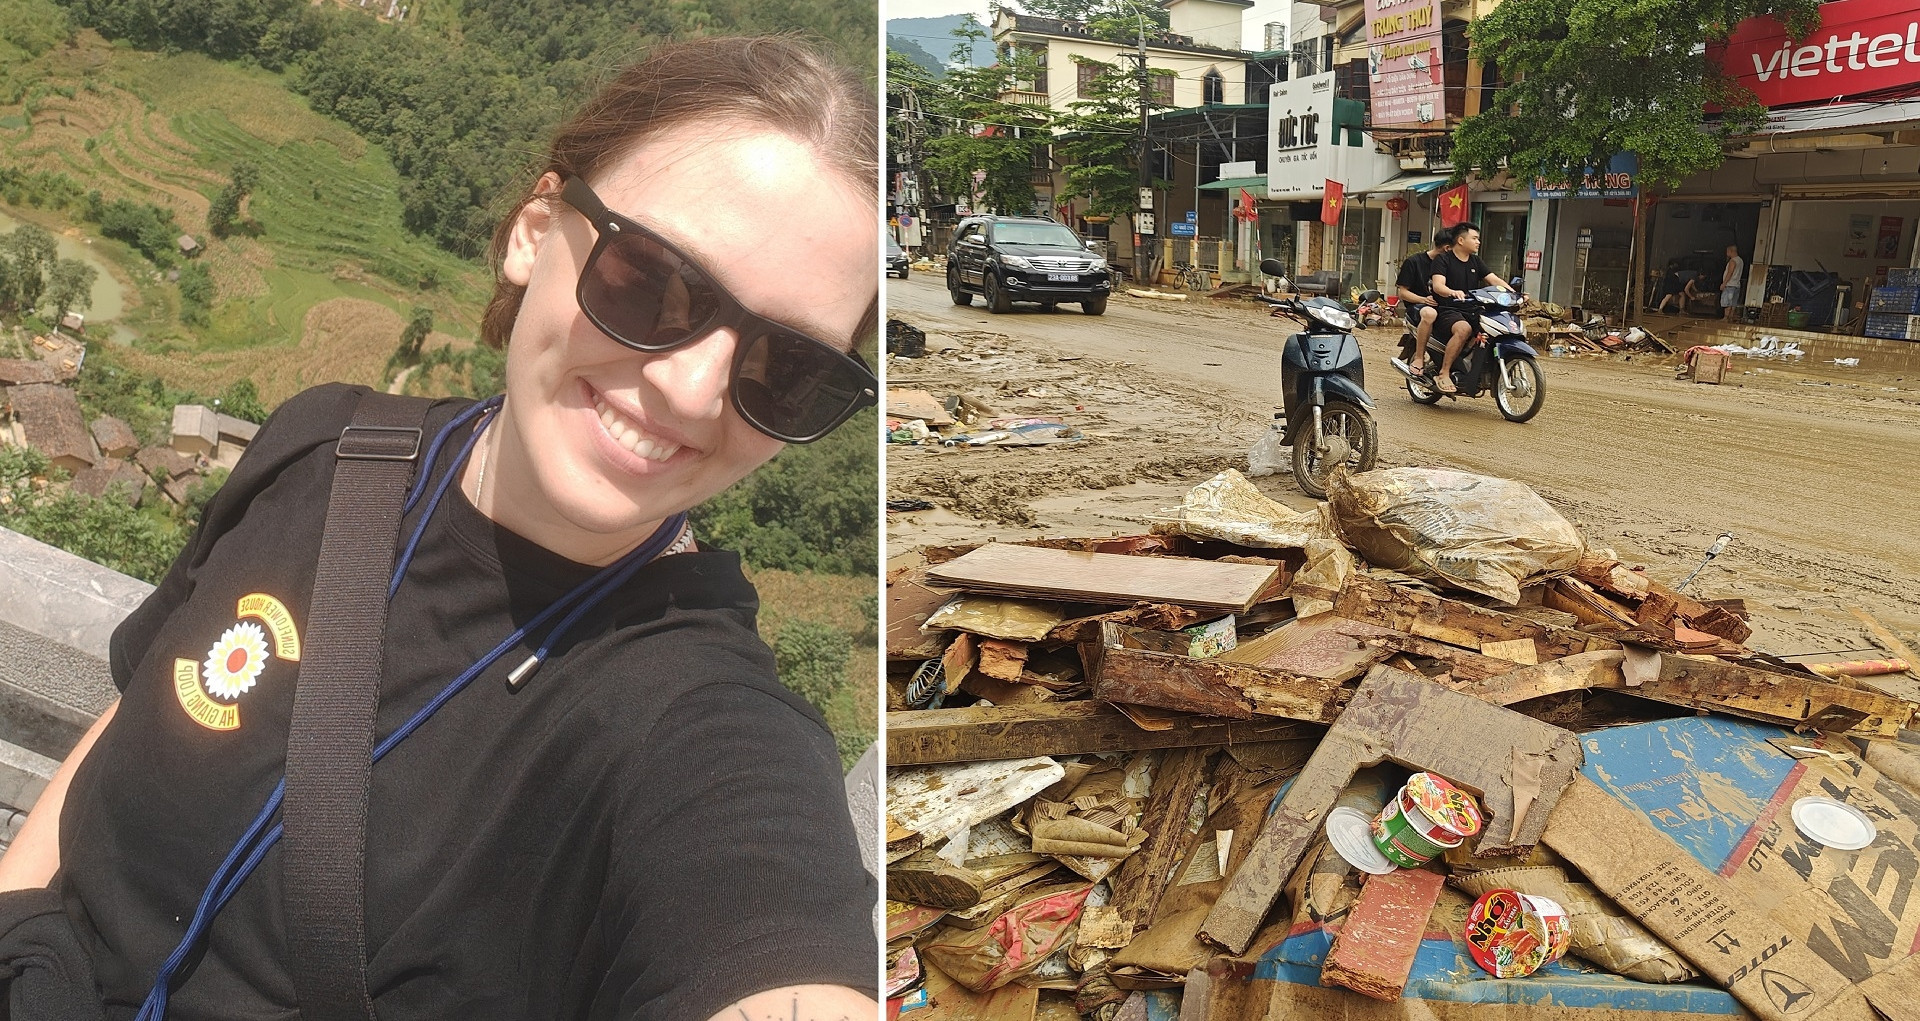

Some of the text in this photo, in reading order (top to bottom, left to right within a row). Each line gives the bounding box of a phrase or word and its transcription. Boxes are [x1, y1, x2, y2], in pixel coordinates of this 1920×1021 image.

[1371, 13, 1404, 38] TRUNG
[1752, 22, 1920, 82] viettel
[1299, 105, 1319, 146] TÓC
[1621, 771, 1691, 793] MADE IN CHINA
[1653, 861, 1672, 872] SIZE:
[1674, 906, 1687, 918] SET
[1702, 897, 1720, 909] BIKE
[1674, 903, 1728, 941] TOTEM CHILDREN
[1711, 909, 1736, 927] MODEL:
